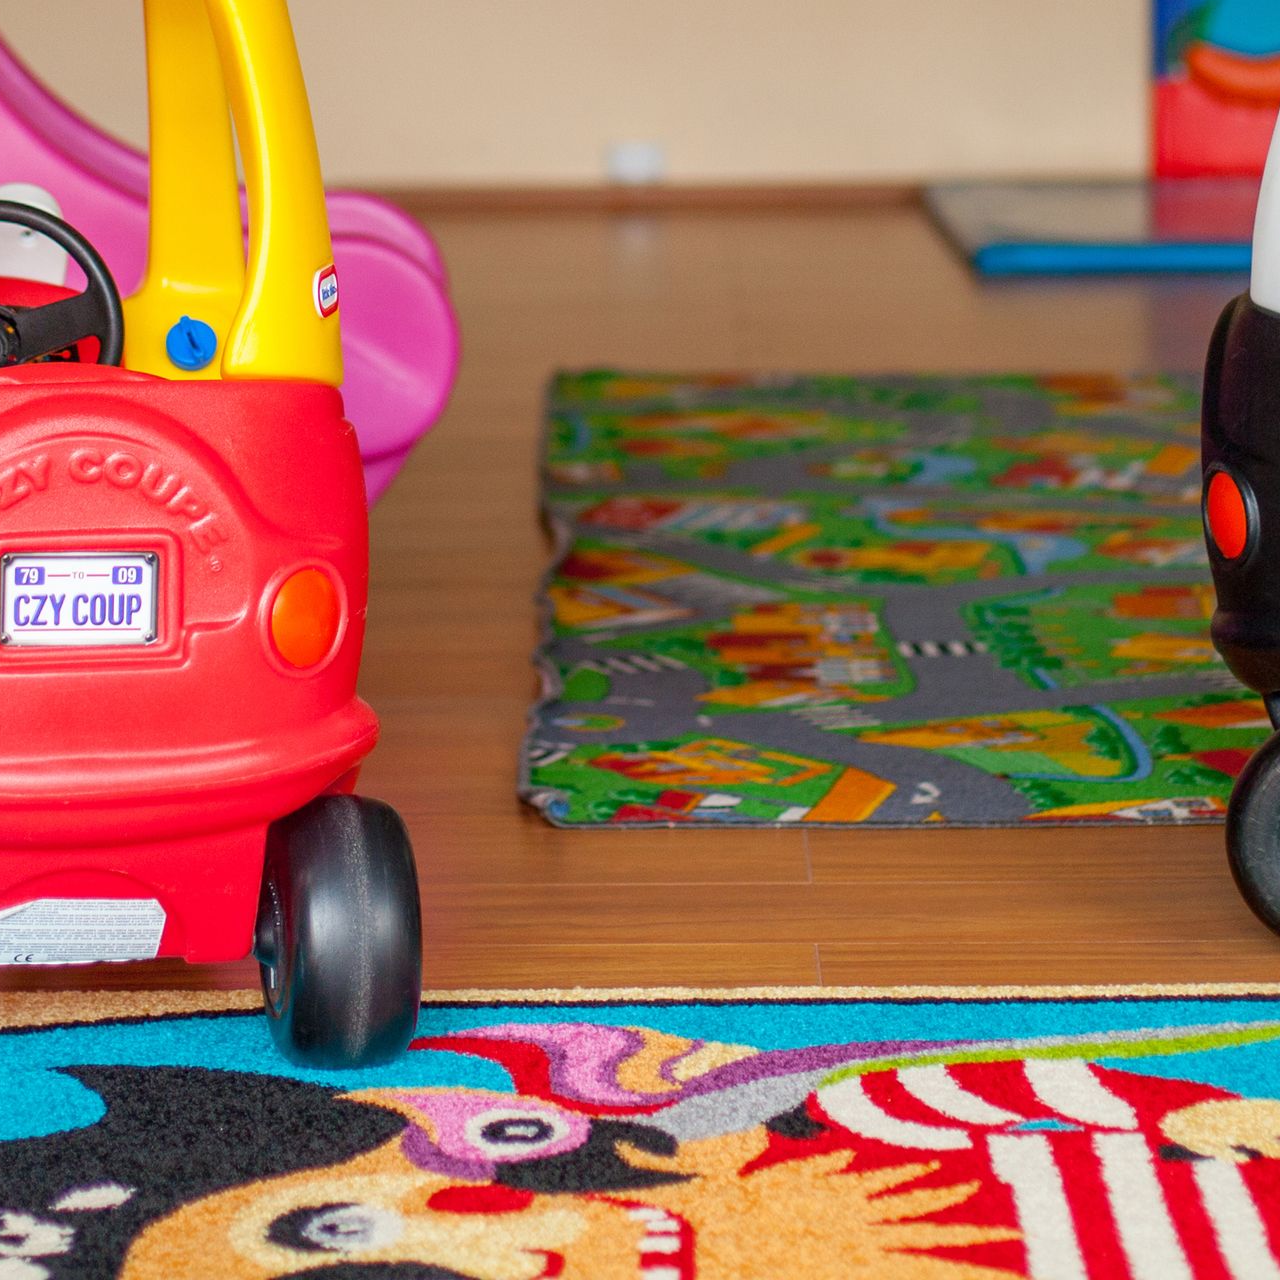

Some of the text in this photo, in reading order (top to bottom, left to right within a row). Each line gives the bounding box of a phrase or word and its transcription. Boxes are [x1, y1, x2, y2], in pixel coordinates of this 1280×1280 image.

[70, 447, 228, 555] COUPE
[21, 566, 136, 584] 79 TO 09
[13, 592, 142, 627] CZY COUP
